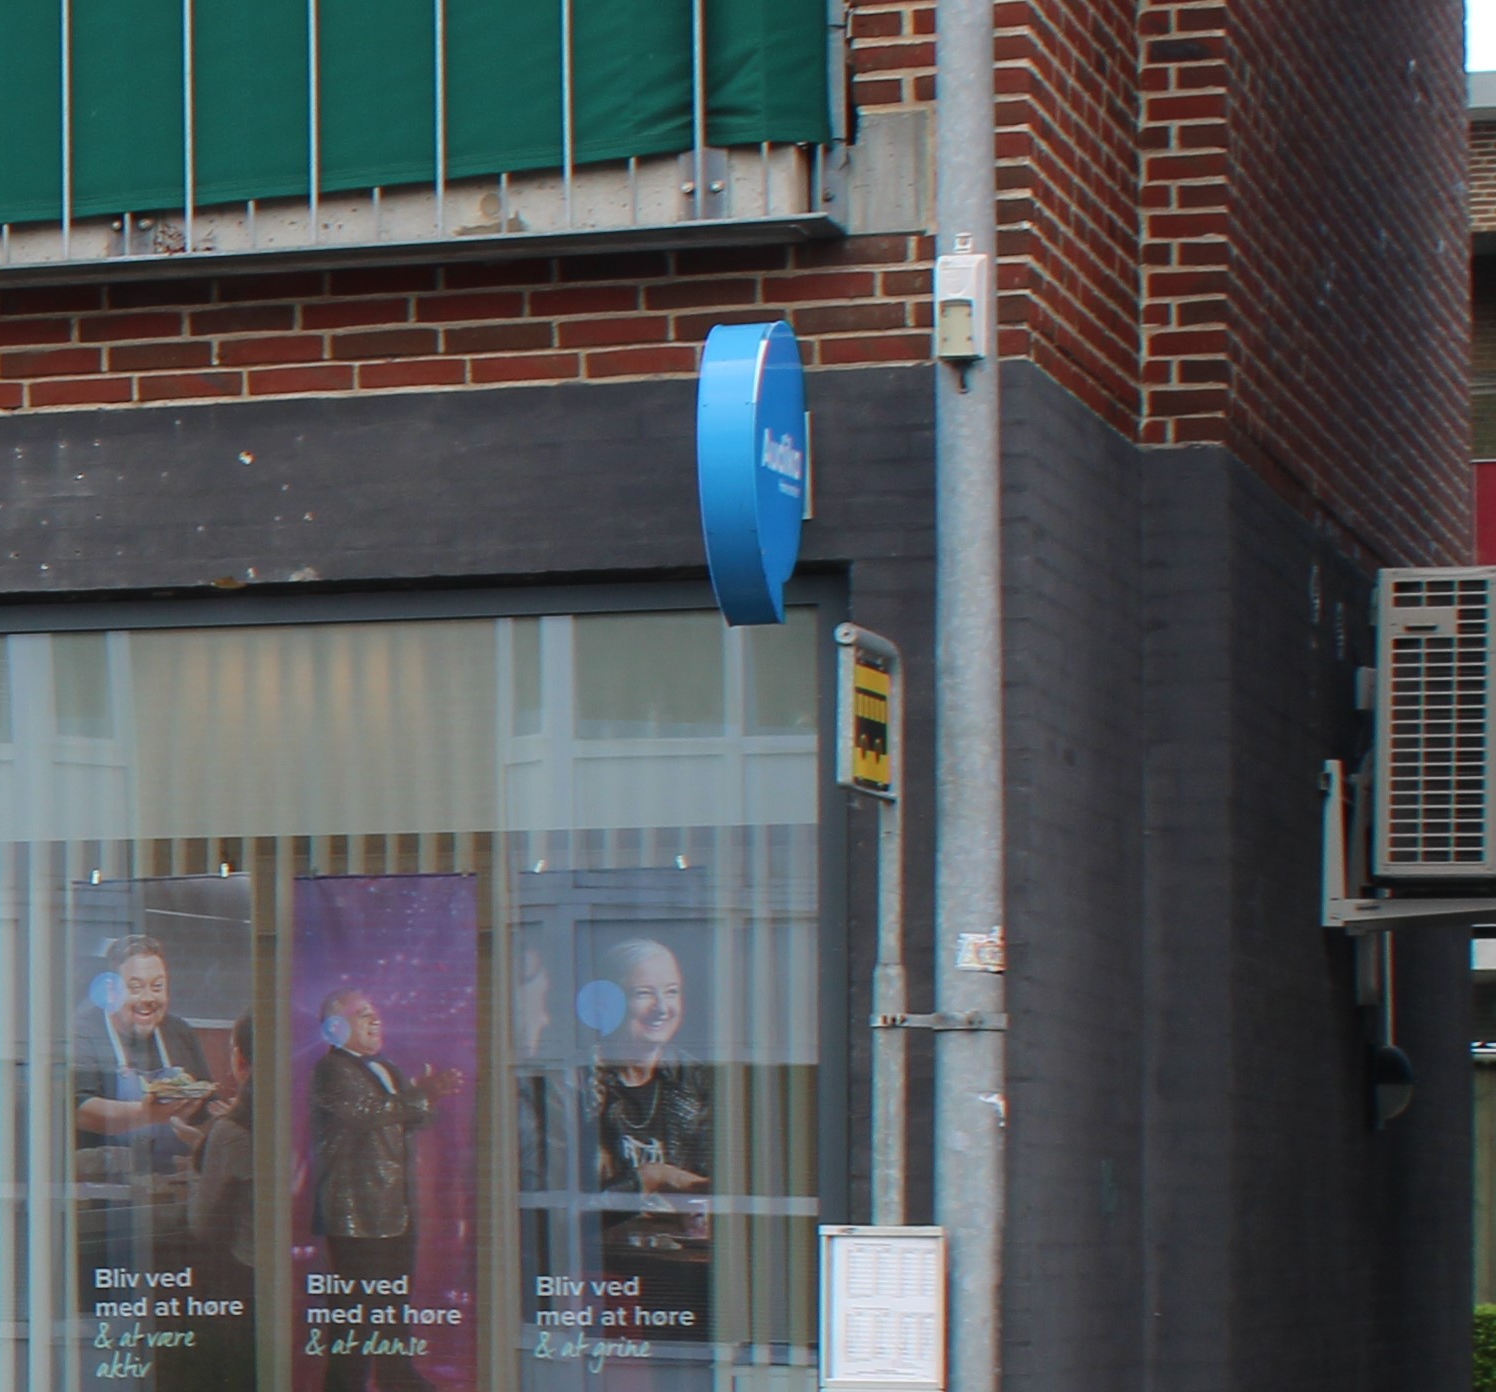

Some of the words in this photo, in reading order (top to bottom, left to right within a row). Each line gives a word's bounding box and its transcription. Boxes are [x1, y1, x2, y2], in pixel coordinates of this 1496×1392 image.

[94, 1268, 139, 1288] Bliv
[145, 1267, 192, 1287] ved
[307, 1274, 355, 1294] Bliv
[361, 1275, 408, 1295] ved
[536, 1276, 584, 1296] Bliv
[591, 1276, 639, 1296] ved
[95, 1297, 147, 1317] med
[155, 1298, 180, 1316] at
[187, 1296, 244, 1316] høre
[307, 1304, 362, 1323] med
[370, 1305, 396, 1324] at
[402, 1304, 462, 1324] høre
[536, 1307, 592, 1326] med
[601, 1307, 627, 1326] at
[634, 1306, 695, 1326] høre
[94, 1322, 113, 1348] &
[119, 1322, 144, 1347] at
[147, 1331, 196, 1347] være
[305, 1328, 327, 1356] &
[331, 1329, 358, 1354] at
[362, 1331, 428, 1356] danse
[535, 1331, 556, 1359] &
[561, 1331, 589, 1357] at
[589, 1337, 652, 1374] grine
[96, 1351, 152, 1378] aktiv
